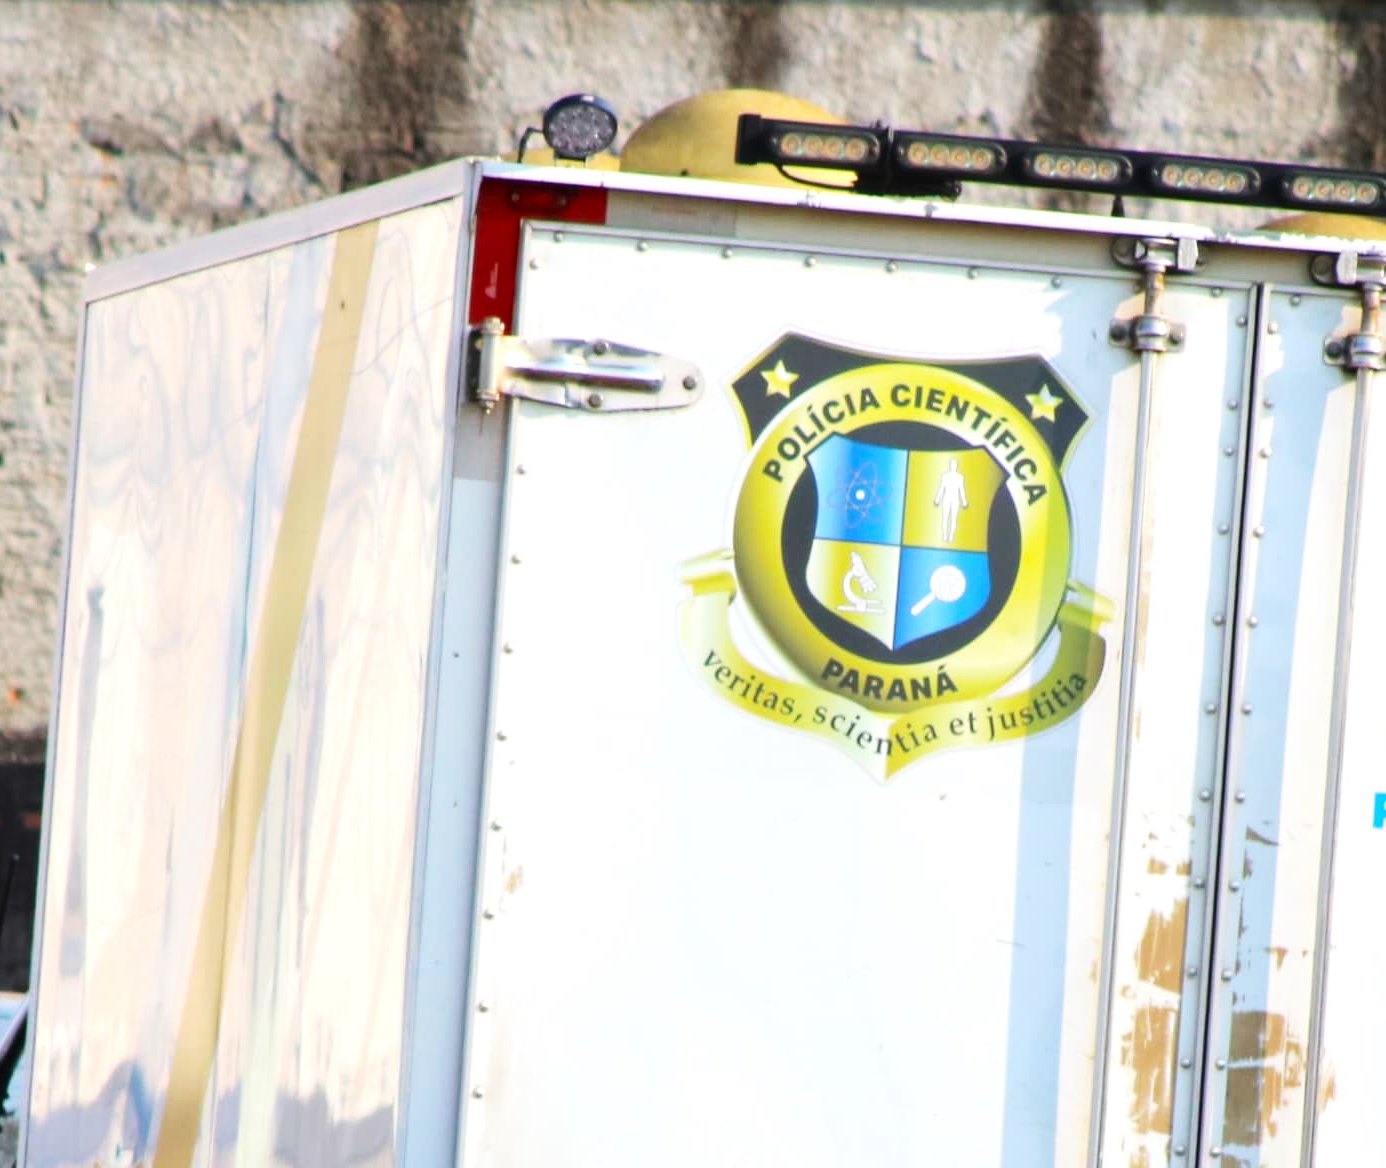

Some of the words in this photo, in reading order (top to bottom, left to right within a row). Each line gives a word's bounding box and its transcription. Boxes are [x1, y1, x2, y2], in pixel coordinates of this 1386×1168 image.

[762, 387, 881, 483] POLÍCIA
[890, 384, 1048, 507] CIENTÍFICA
[702, 649, 803, 724] veritas,
[812, 705, 938, 757] scientia
[949, 711, 979, 737] et
[986, 671, 1089, 742] justitia
[821, 656, 959, 702] PARANÁ
